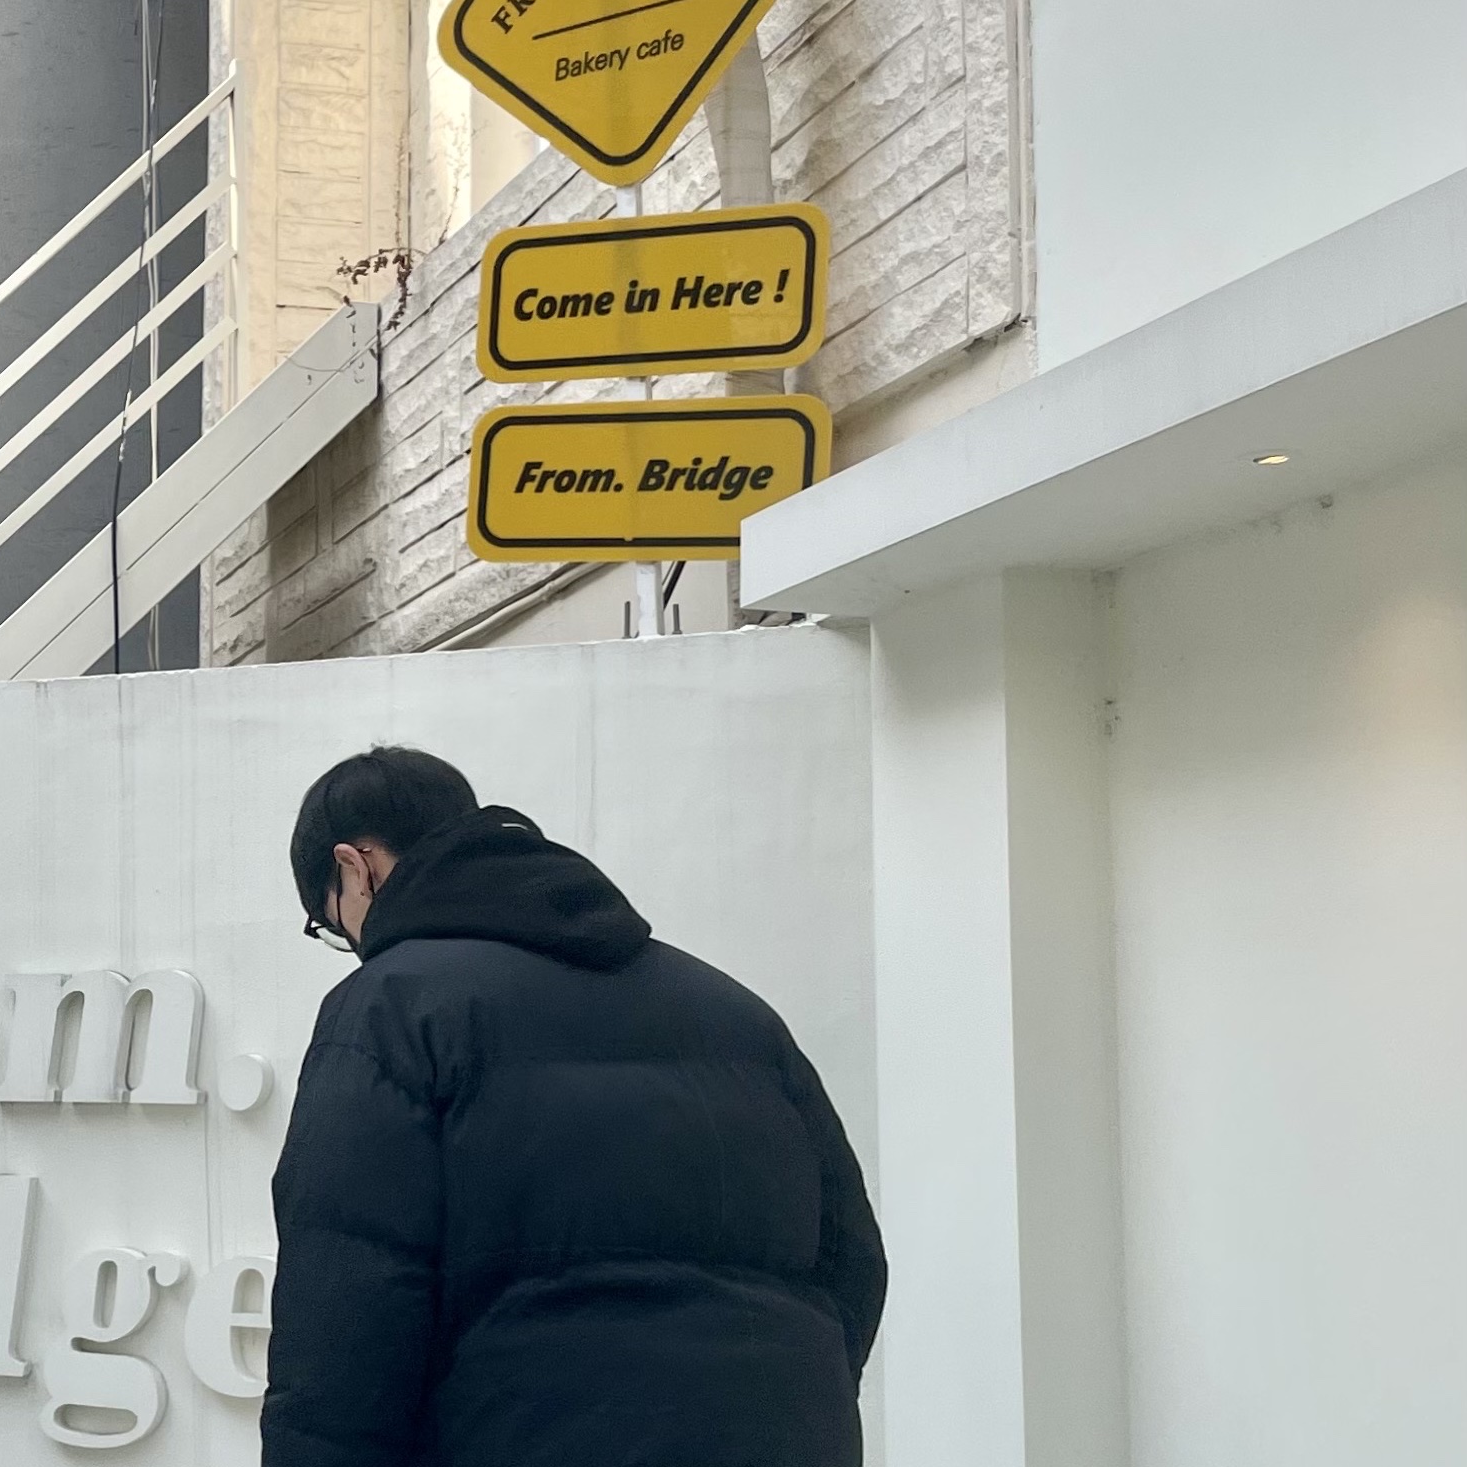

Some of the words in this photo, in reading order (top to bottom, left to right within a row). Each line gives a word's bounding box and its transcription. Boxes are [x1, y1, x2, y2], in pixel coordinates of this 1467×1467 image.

[555, 46, 630, 81] Bakery
[636, 30, 684, 60] cafe
[514, 287, 614, 321] Come
[624, 280, 660, 313] in
[671, 275, 763, 310] Here
[514, 461, 623, 493] From.
[637, 456, 774, 500] Bridge
